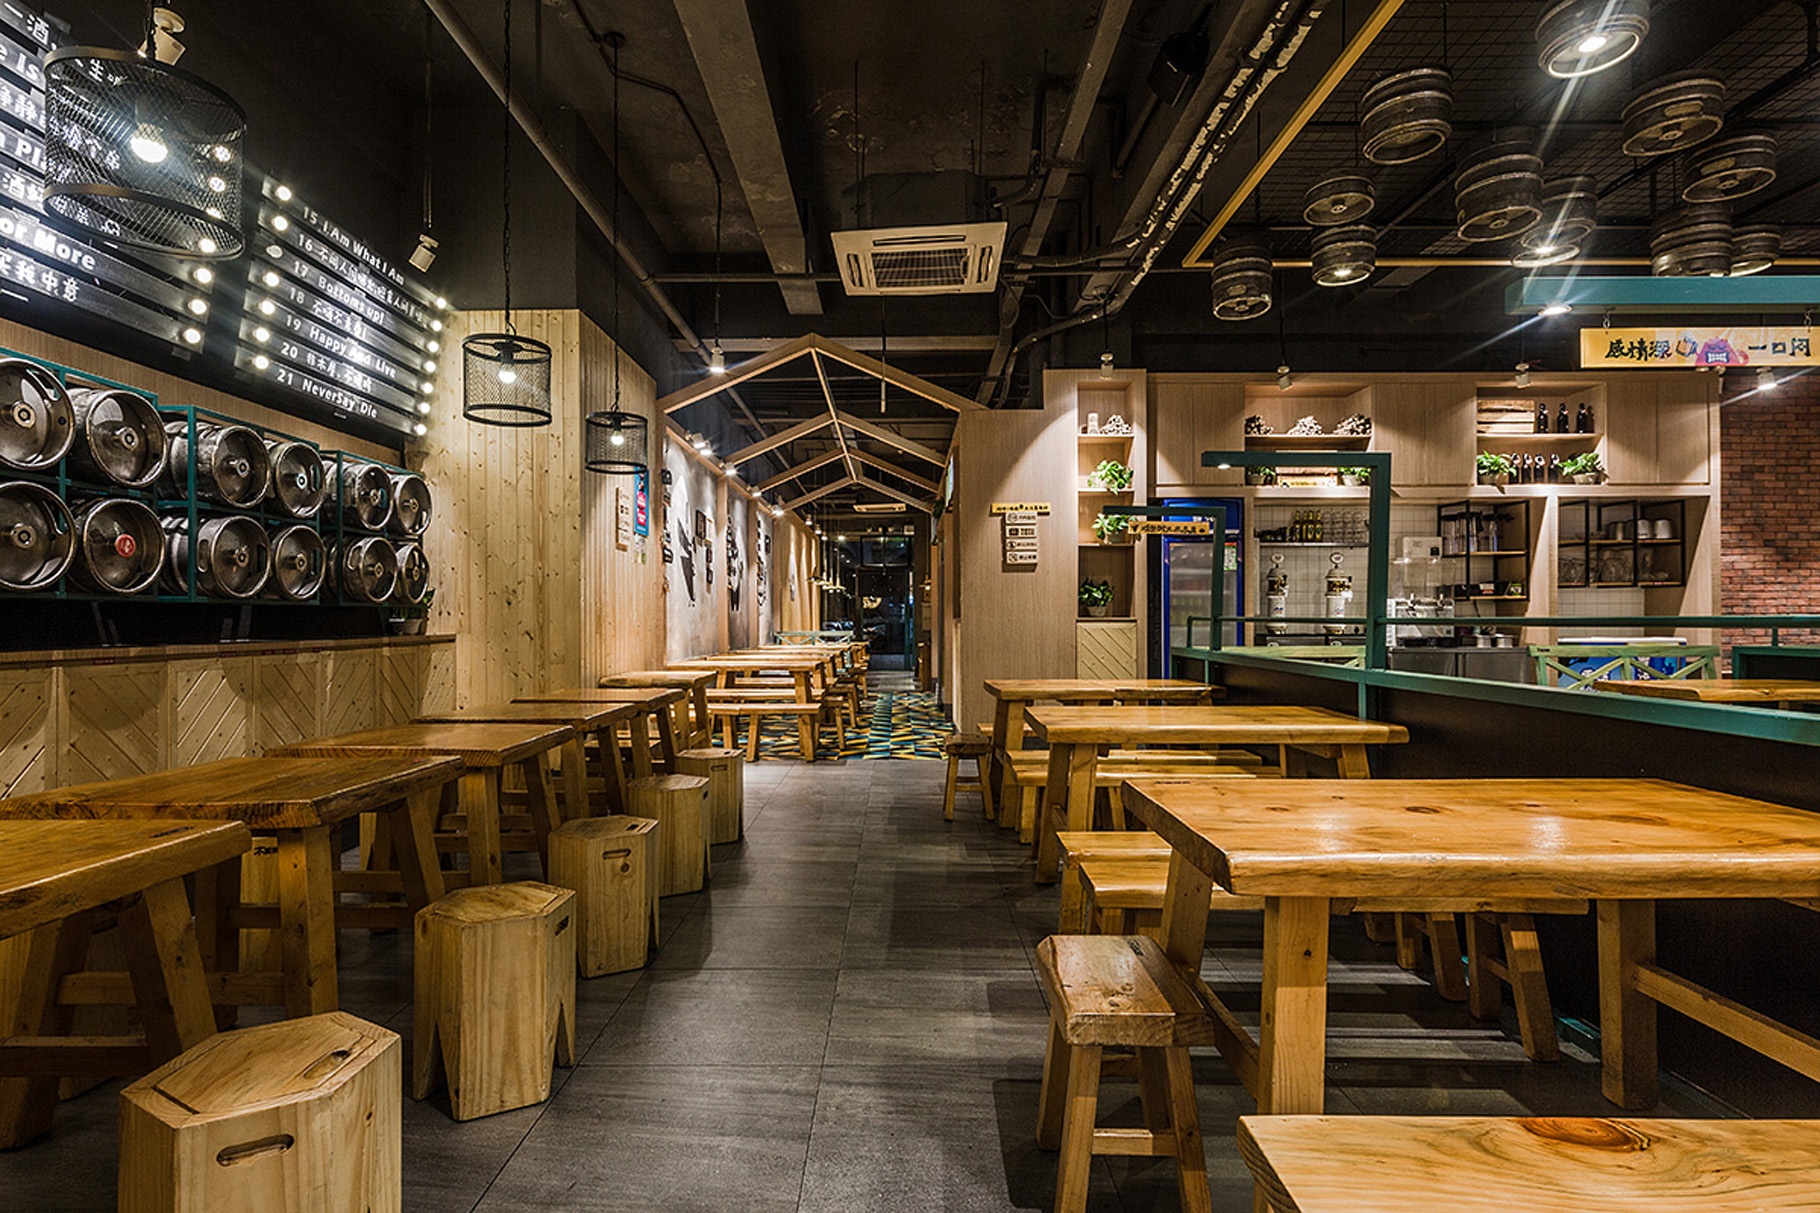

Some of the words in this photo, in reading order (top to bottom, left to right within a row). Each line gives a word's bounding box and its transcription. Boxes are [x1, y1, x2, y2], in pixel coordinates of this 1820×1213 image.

[34, 228, 96, 271] More
[298, 233, 314, 252] 16
[302, 206, 318, 225] 15
[330, 227, 351, 248] Am
[352, 240, 382, 270] What
[388, 268, 406, 286] Am
[289, 287, 305, 304] 18
[293, 261, 309, 278] 17
[318, 276, 365, 313] Bottoms
[281, 342, 298, 360] 20
[286, 314, 302, 331] 19
[309, 326, 347, 355] Happy
[349, 345, 372, 366] And
[375, 361, 397, 379] Live
[276, 368, 294, 386] 21
[360, 402, 378, 419] Die
